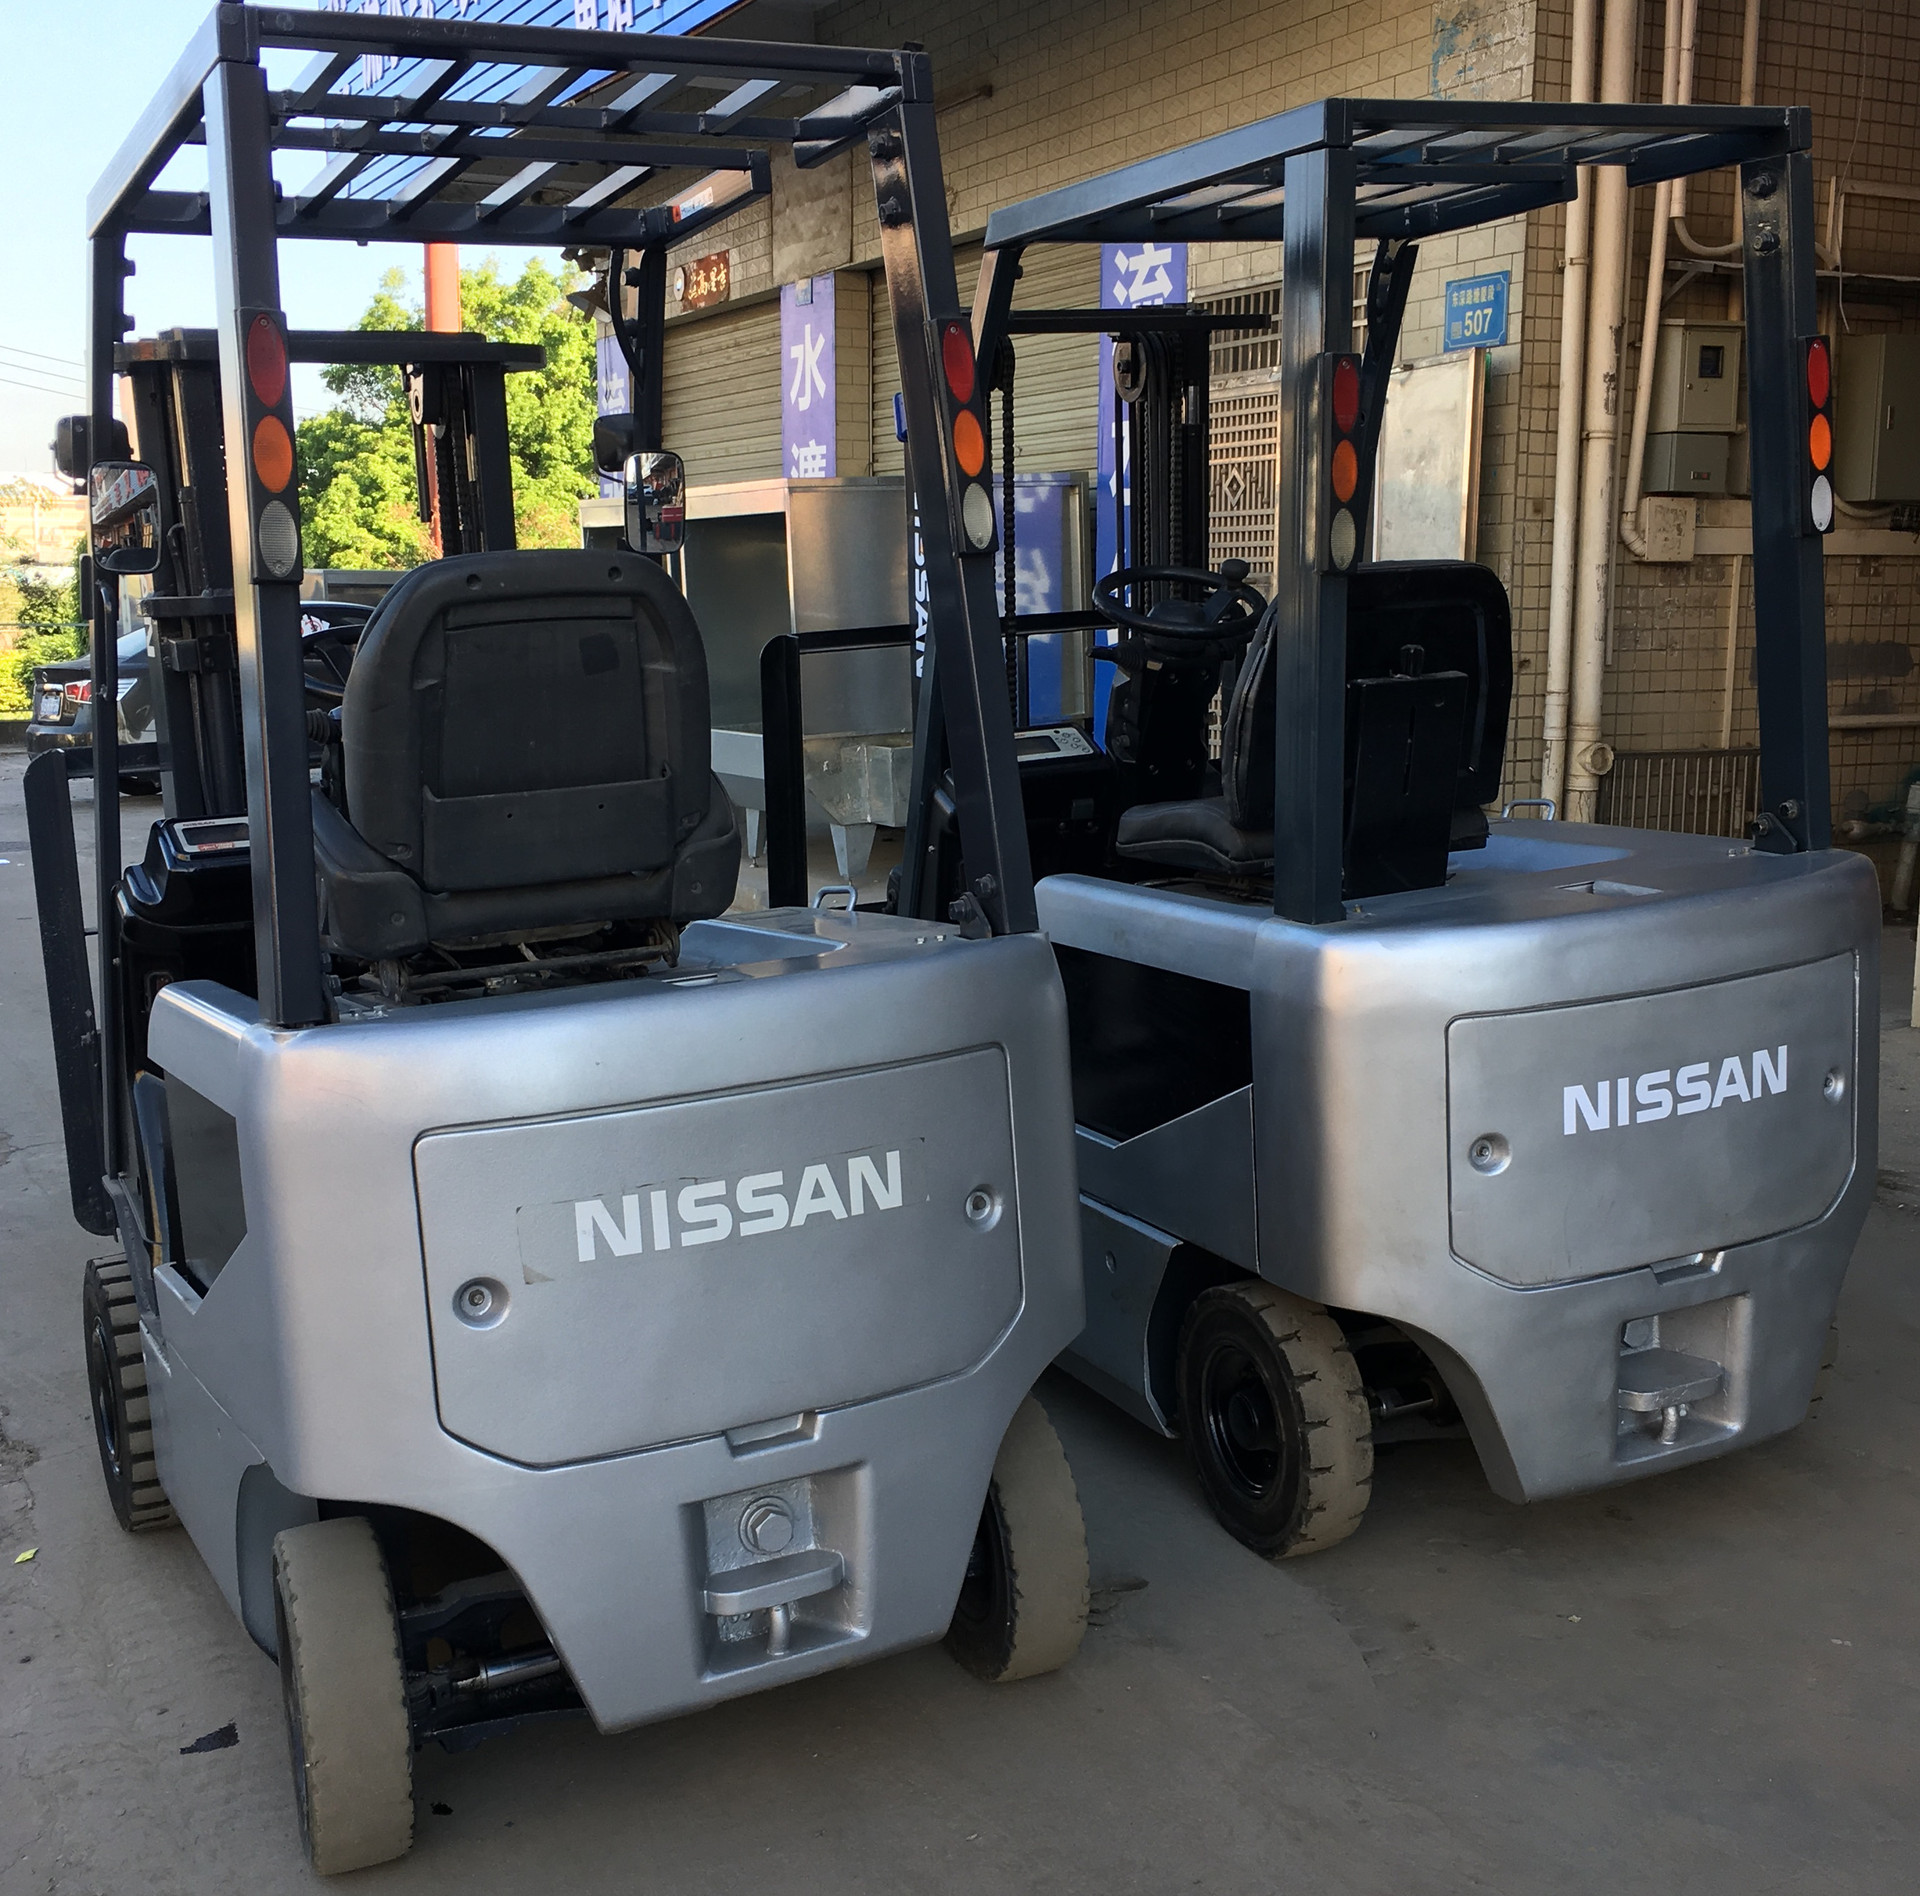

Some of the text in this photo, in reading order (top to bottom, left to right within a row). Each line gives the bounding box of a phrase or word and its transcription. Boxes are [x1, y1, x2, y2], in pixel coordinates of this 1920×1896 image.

[1464, 308, 1493, 336] 507
[1563, 1045, 1788, 1135] NISSAN
[575, 1150, 903, 1261] NISSAN
